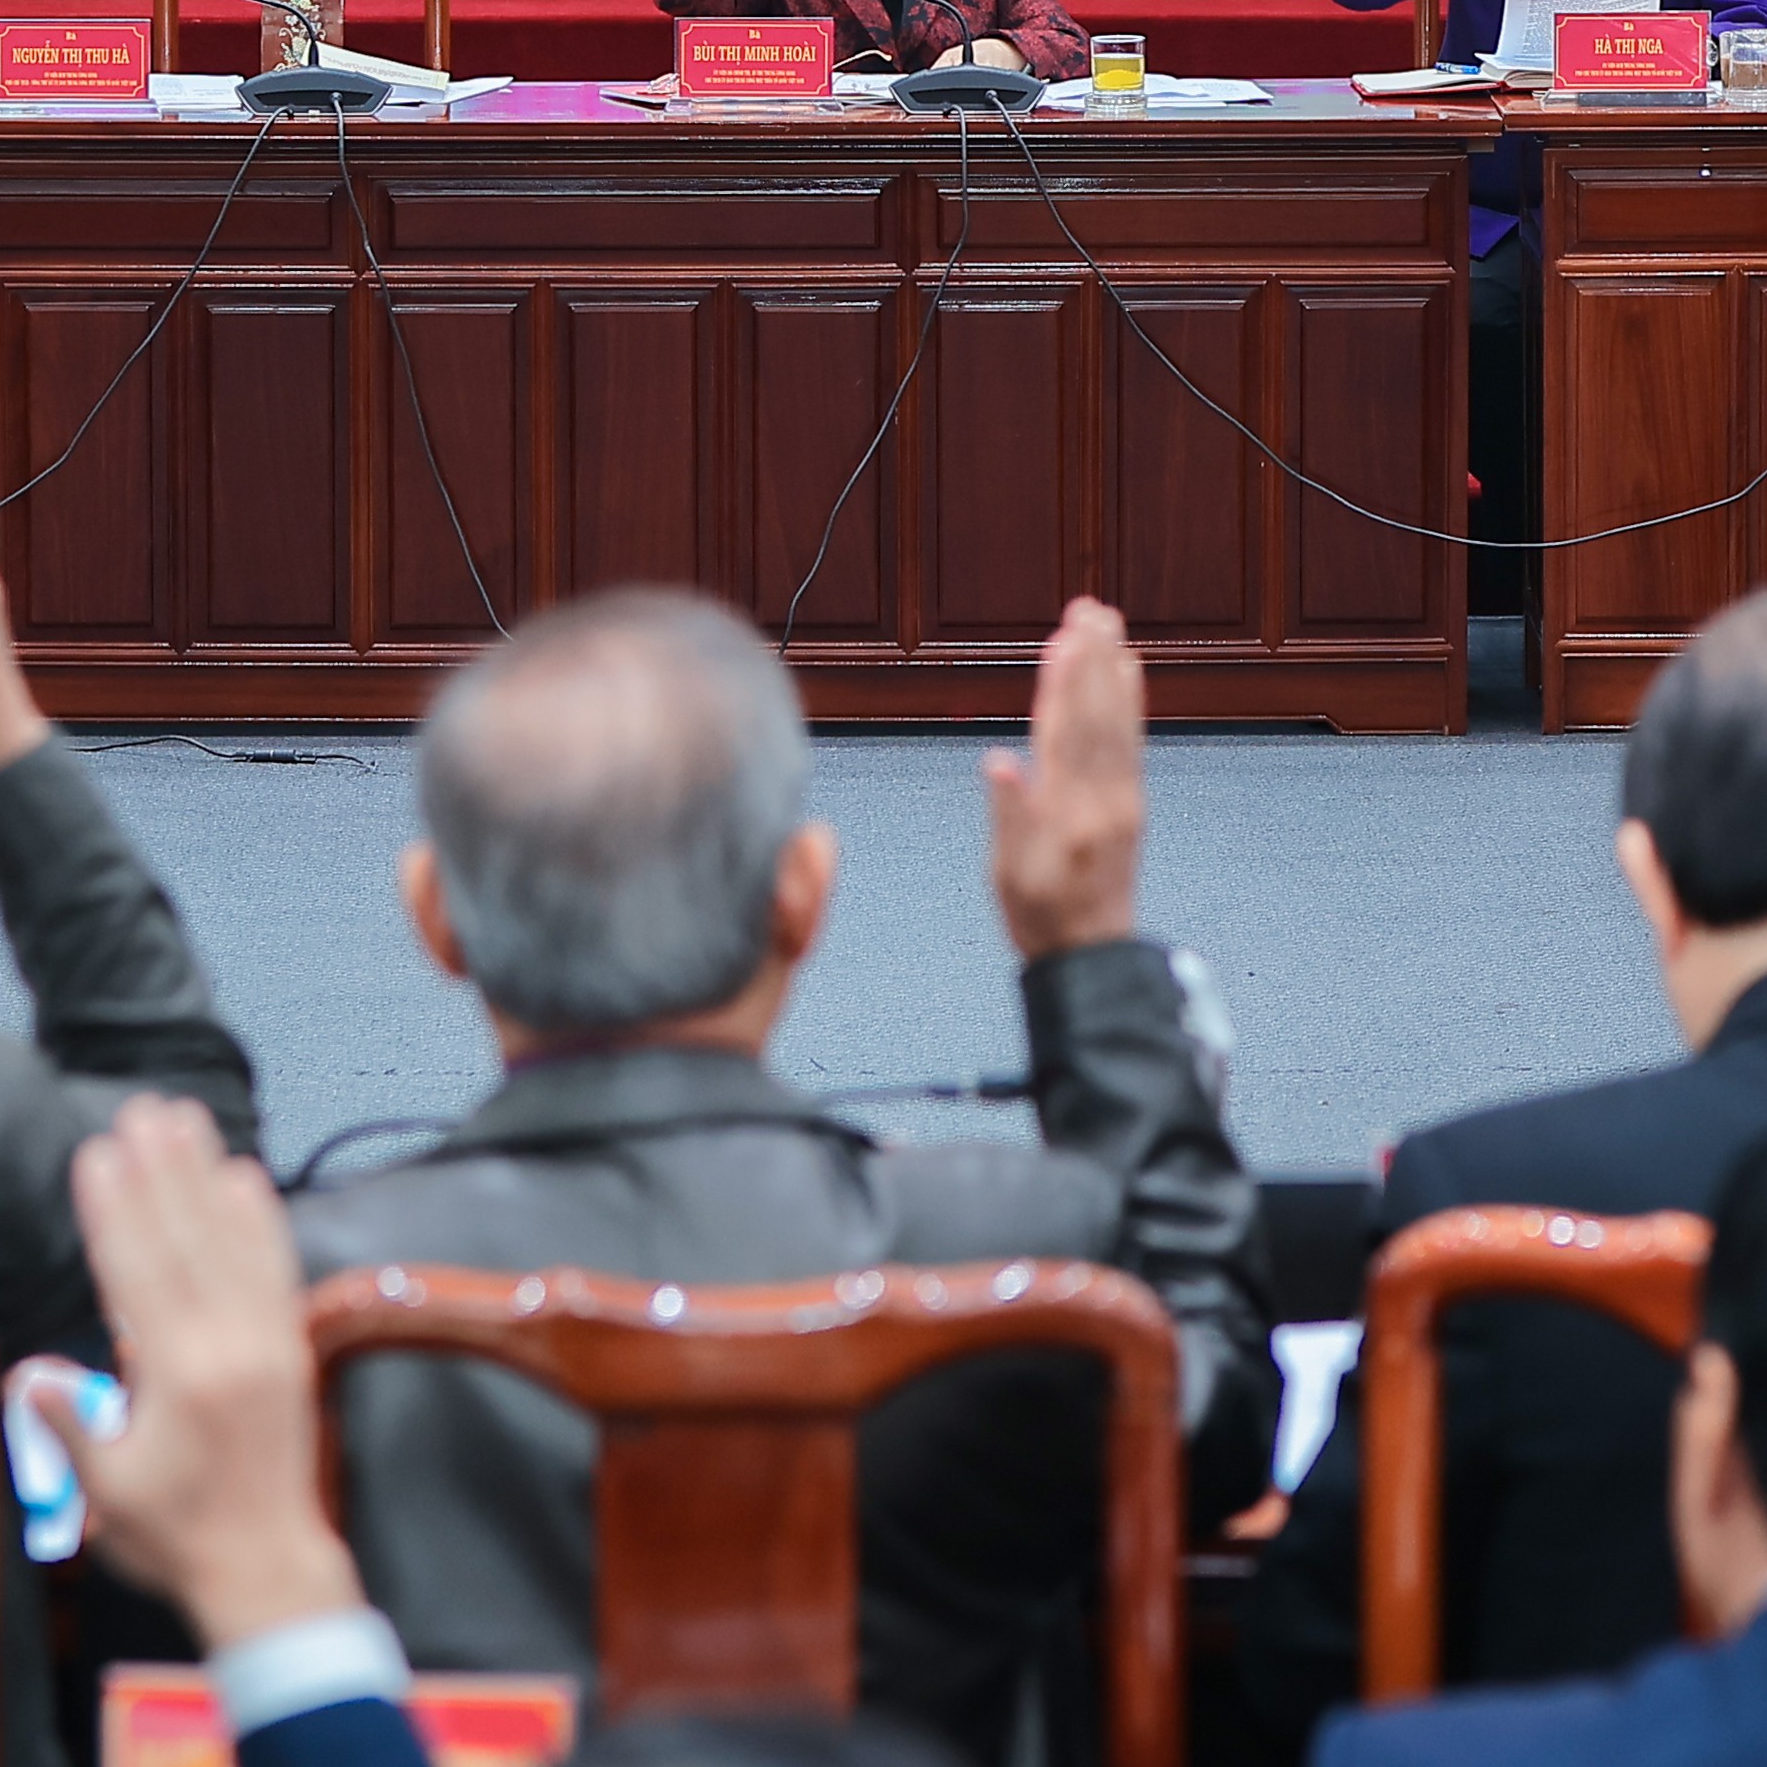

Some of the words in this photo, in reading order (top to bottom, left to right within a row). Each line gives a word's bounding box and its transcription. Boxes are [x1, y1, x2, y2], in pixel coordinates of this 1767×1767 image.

[748, 29, 761, 39] Bà
[1594, 33, 1612, 55] HÀ
[1615, 38, 1635, 59] THỊ
[1638, 38, 1664, 55] NGA
[12, 40, 60, 64] NGUYỄN
[62, 47, 82, 68] THỊ
[85, 47, 109, 64] THU
[112, 43, 130, 64] HÀ
[693, 40, 715, 62] BÙI
[718, 45, 741, 66] THỊ
[744, 45, 780, 62] MINH
[783, 41, 816, 62] HOÀI
